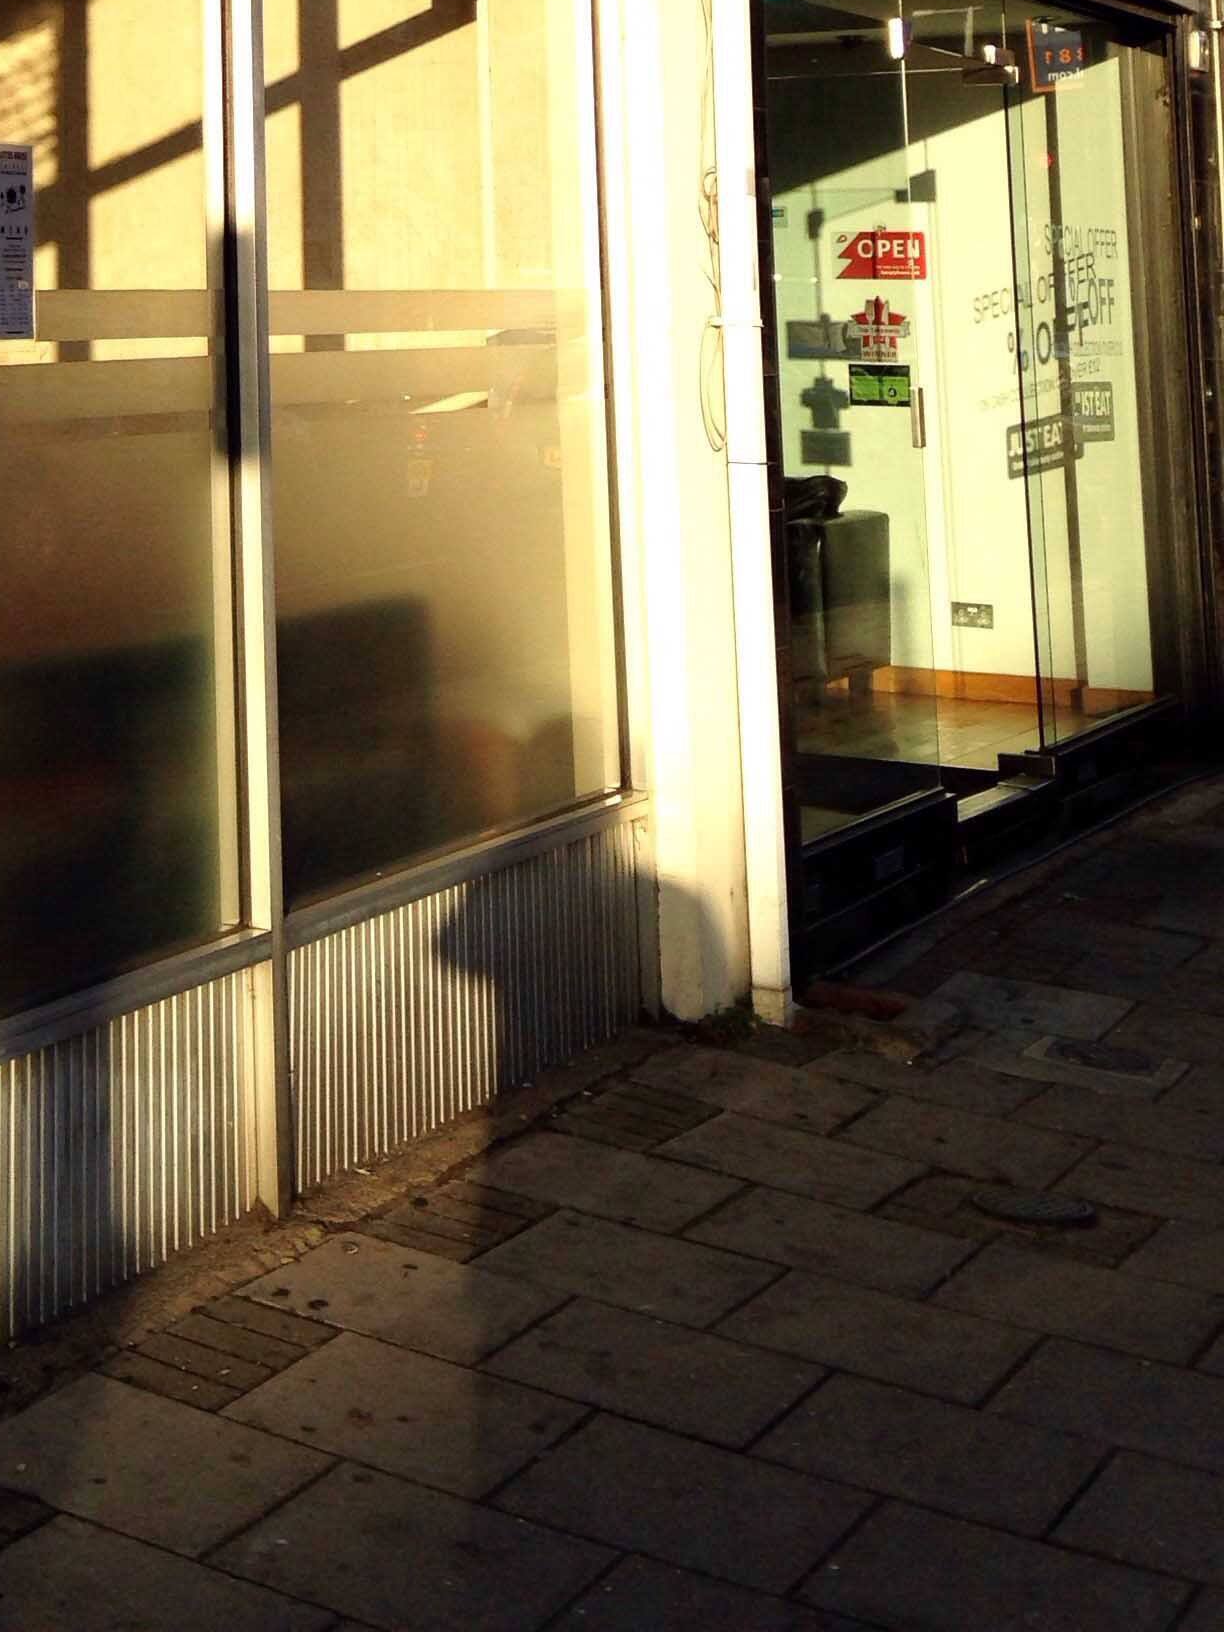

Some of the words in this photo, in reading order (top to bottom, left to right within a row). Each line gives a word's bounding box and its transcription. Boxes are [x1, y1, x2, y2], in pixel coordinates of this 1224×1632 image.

[856, 238, 921, 259] OPEN
[1043, 223, 1082, 257] SCIAL
[973, 282, 1033, 325] SPECAL
